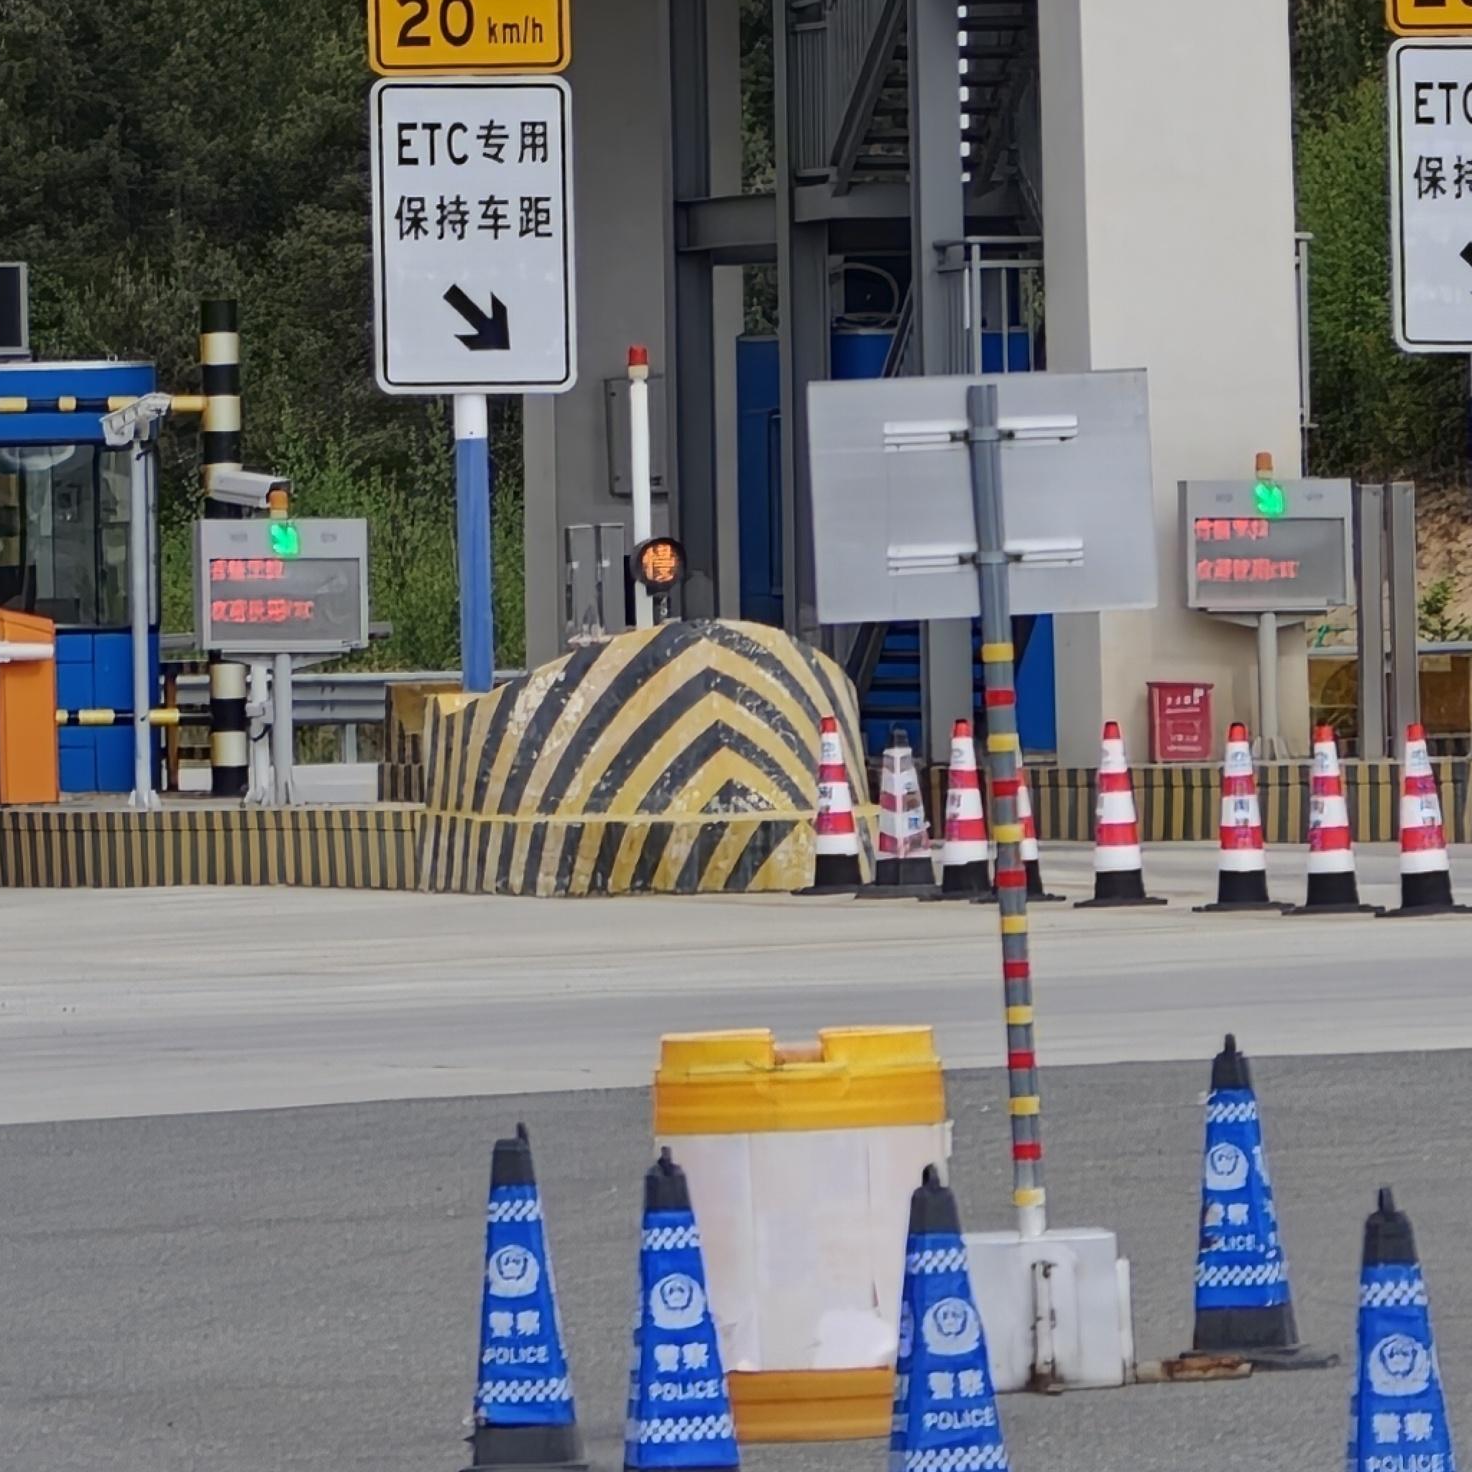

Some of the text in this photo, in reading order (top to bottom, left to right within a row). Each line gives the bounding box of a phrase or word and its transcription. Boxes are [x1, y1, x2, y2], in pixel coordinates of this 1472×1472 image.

[487, 16, 544, 45] km/h
[396, 119, 549, 166] ETC专用
[394, 194, 554, 240] 保持车距
[483, 1345, 550, 1365] POLICE
[649, 1379, 720, 1402] POLICE
[922, 1406, 996, 1432] POLICE
